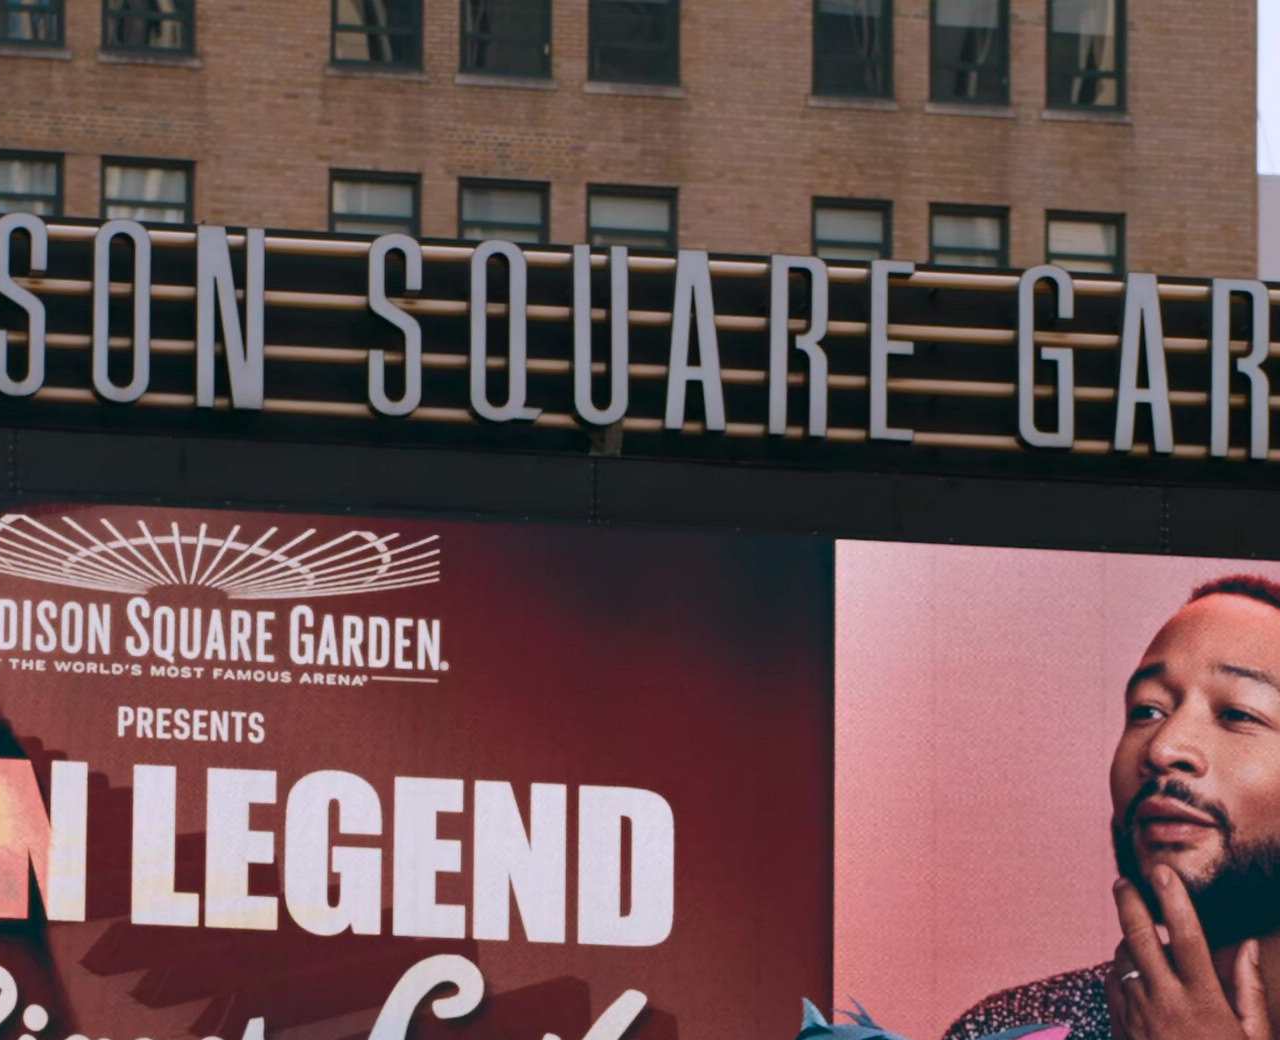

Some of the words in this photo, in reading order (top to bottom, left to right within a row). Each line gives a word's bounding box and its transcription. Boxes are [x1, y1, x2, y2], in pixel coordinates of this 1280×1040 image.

[368, 233, 915, 441] SQUARE
[125, 597, 275, 664] SQUARE
[9, 658, 46, 671] THE
[54, 661, 142, 676] WORLD'S
[150, 665, 204, 679] MOST
[212, 667, 292, 683] FAMOUS
[117, 706, 265, 743] PRESENTS
[131, 763, 675, 948] LEGEND
